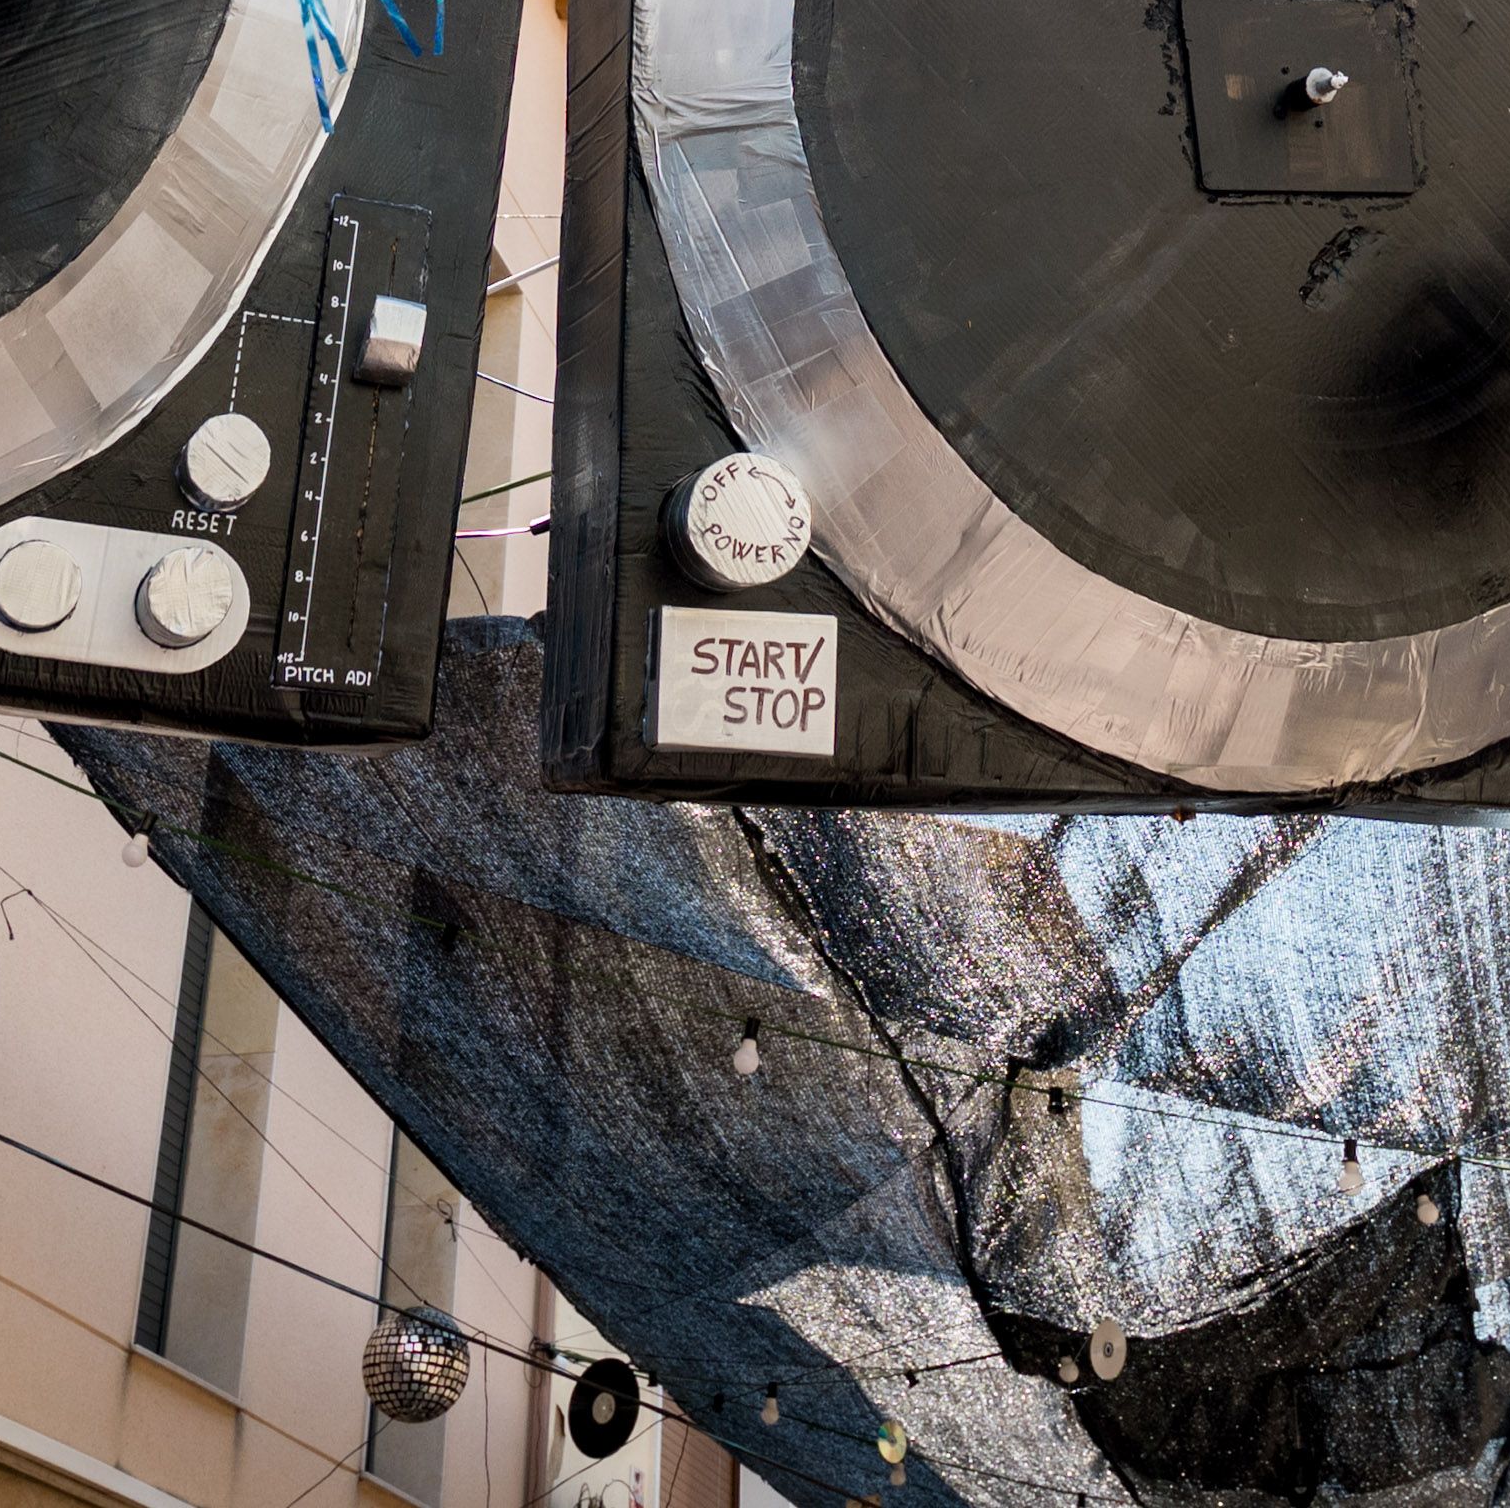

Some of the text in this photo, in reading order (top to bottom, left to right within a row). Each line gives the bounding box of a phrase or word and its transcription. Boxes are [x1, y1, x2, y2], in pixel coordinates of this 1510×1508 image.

[332, 259, 343, 271] 10
[330, 296, 340, 308] 8
[324, 333, 333, 345] 6
[319, 372, 329, 385] 4
[314, 412, 322, 424] 2
[309, 453, 318, 465] 2
[701, 462, 741, 503] OFF
[304, 490, 313, 502] 4
[171, 510, 238, 536] RESET
[300, 530, 309, 542] 6
[783, 515, 806, 552] ON
[703, 522, 786, 565] POWER
[295, 570, 304, 583] 8
[288, 611, 300, 623] 10
[690, 636, 826, 685] START/
[284, 665, 334, 685] PITCH
[723, 686, 826, 733] STOP
